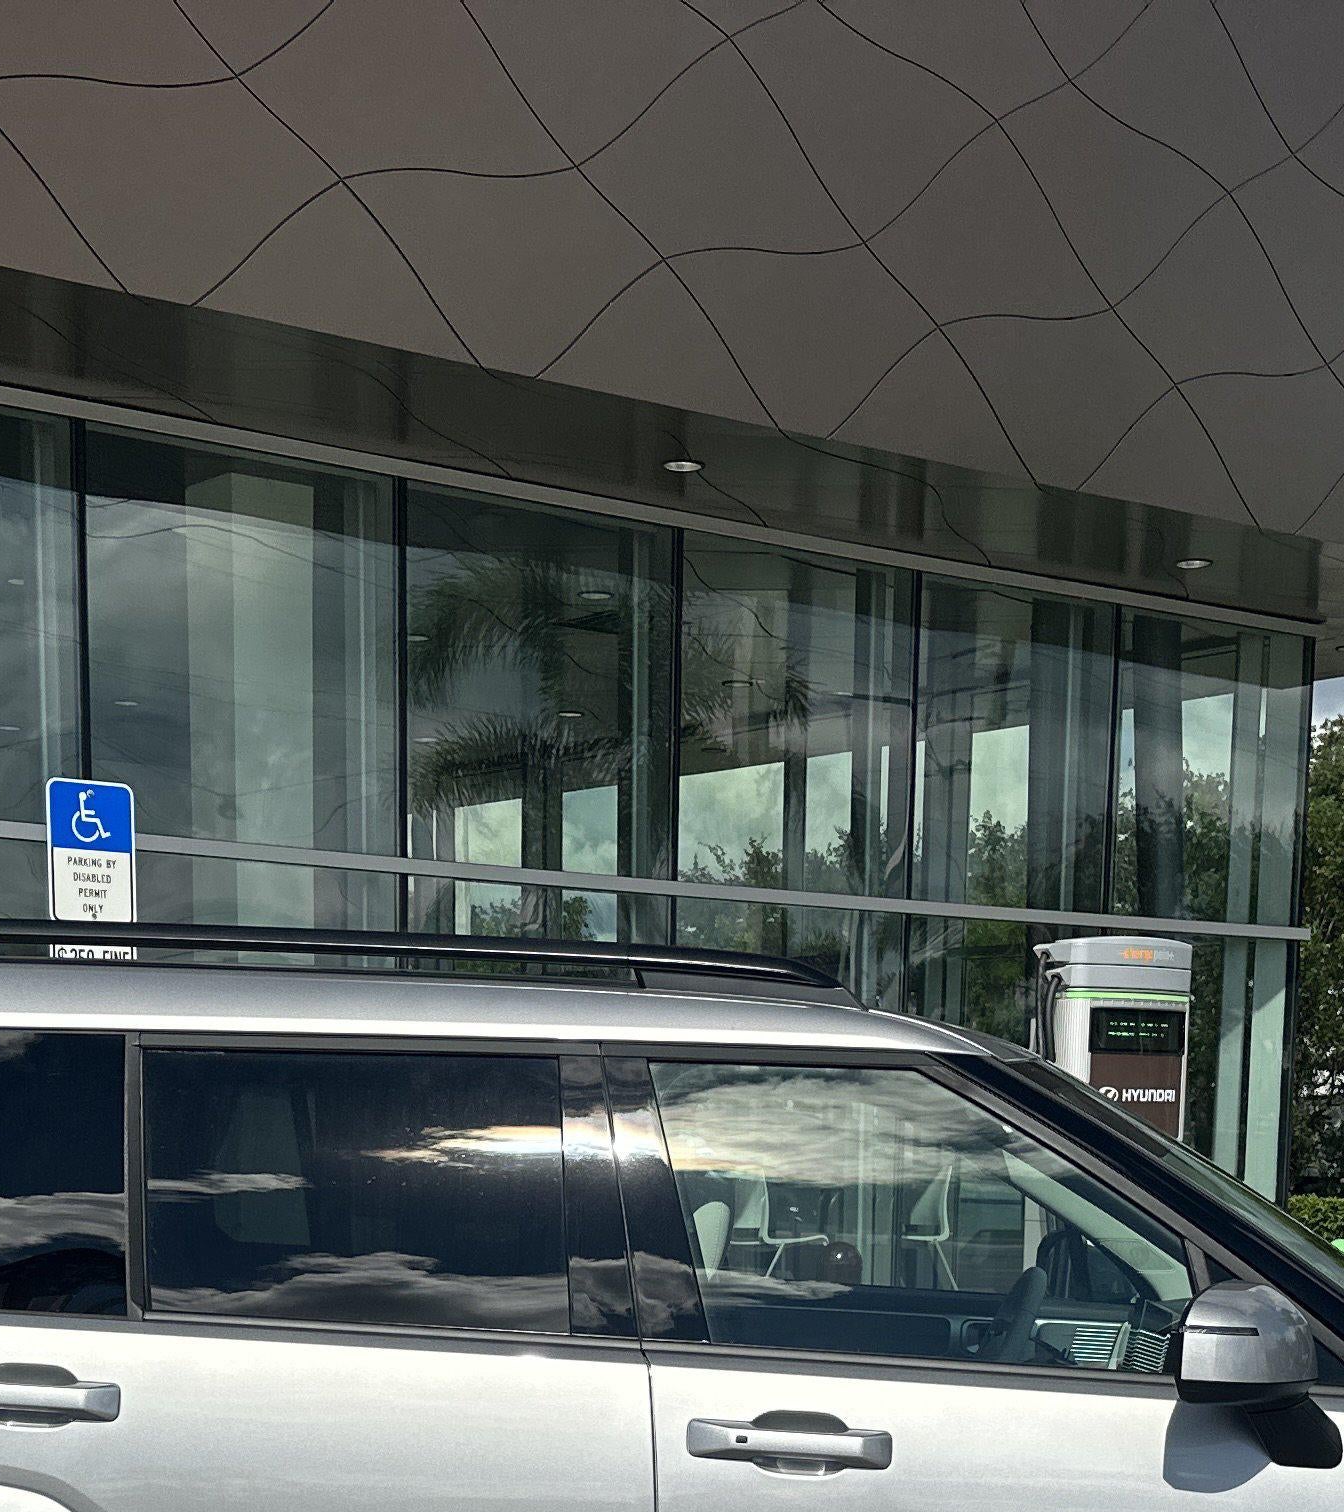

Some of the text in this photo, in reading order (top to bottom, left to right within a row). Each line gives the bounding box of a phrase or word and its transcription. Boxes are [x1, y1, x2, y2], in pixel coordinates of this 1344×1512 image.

[67, 856, 117, 869] PARKING BY
[73, 872, 112, 884] DISABLED
[78, 887, 108, 899] PERMIT
[82, 903, 104, 914] ONLY
[1122, 1088, 1176, 1102] HYUNDAI
